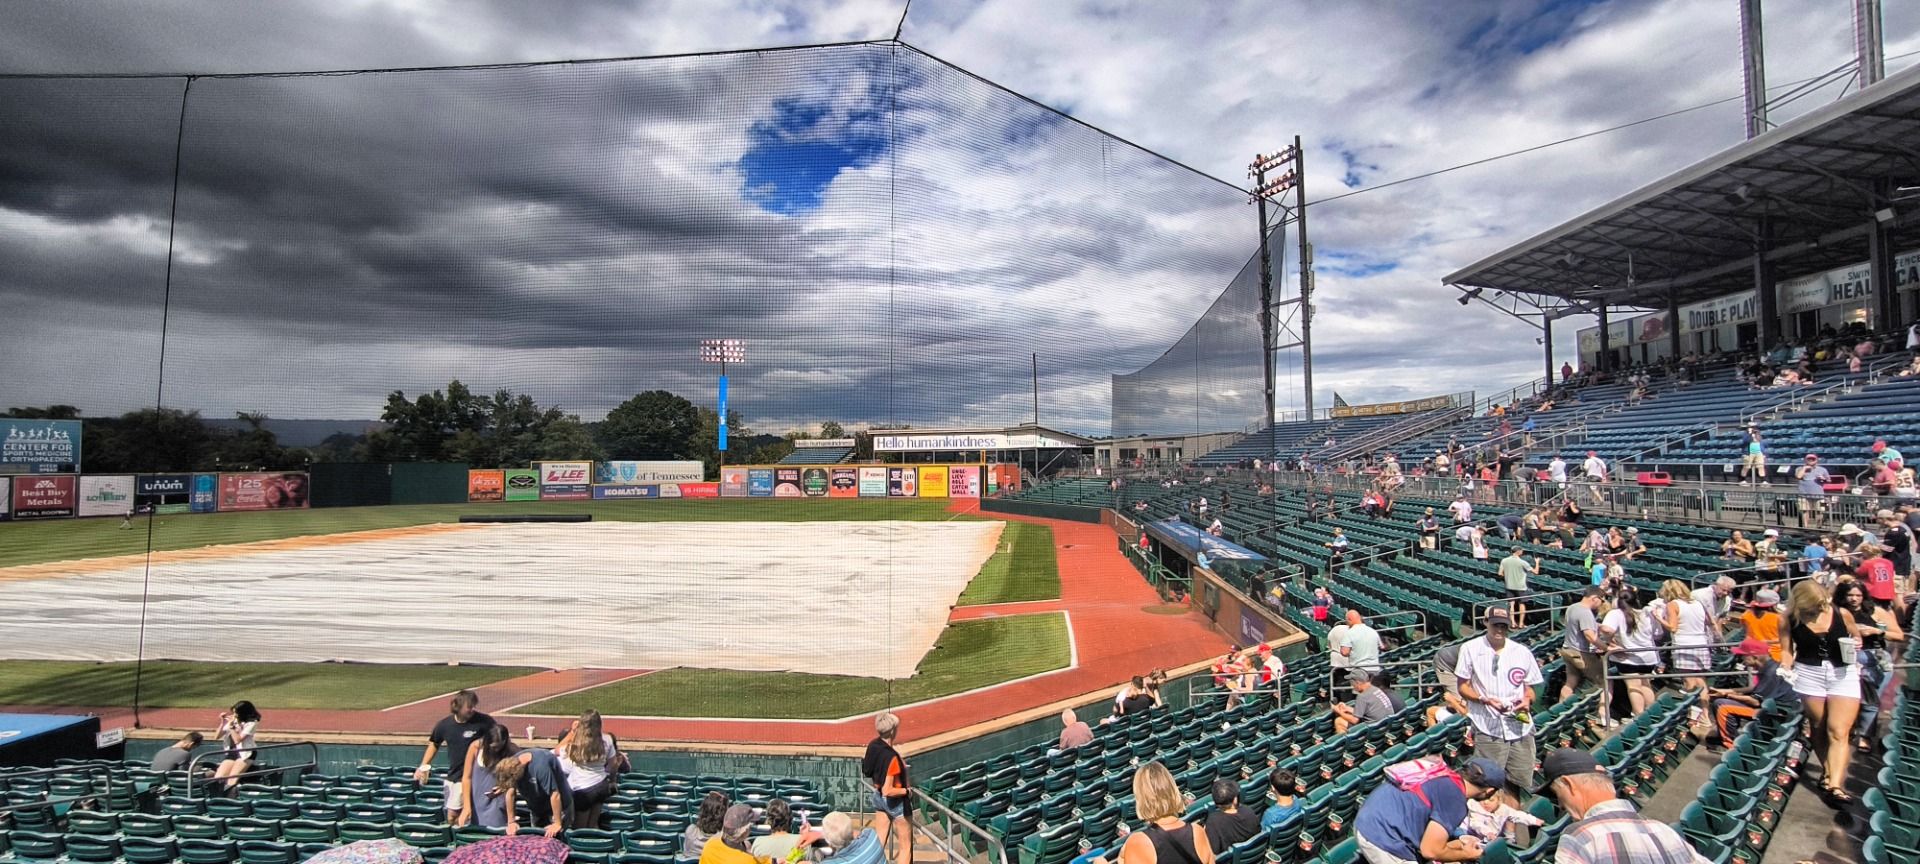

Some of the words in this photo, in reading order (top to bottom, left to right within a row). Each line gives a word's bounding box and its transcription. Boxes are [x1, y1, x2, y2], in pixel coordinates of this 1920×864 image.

[1848, 269, 1870, 280] SWIN
[1896, 266, 1920, 286] CA
[1833, 278, 1873, 300] HEAL
[1689, 308, 1728, 330] DOUBLE
[1729, 296, 1756, 322] PLAY
[3, 443, 48, 451] CENTER
[51, 443, 73, 451] FOR
[877, 437, 904, 449] Hello
[906, 436, 997, 448] humankindness
[560, 470, 586, 478] LEE
[651, 472, 701, 480] Tennessee
[1896, 477, 1912, 488] 25
[22, 489, 44, 497] Best
[47, 489, 68, 498] Buy
[604, 487, 648, 496] KOMATSU
[27, 498, 63, 506] Metals
